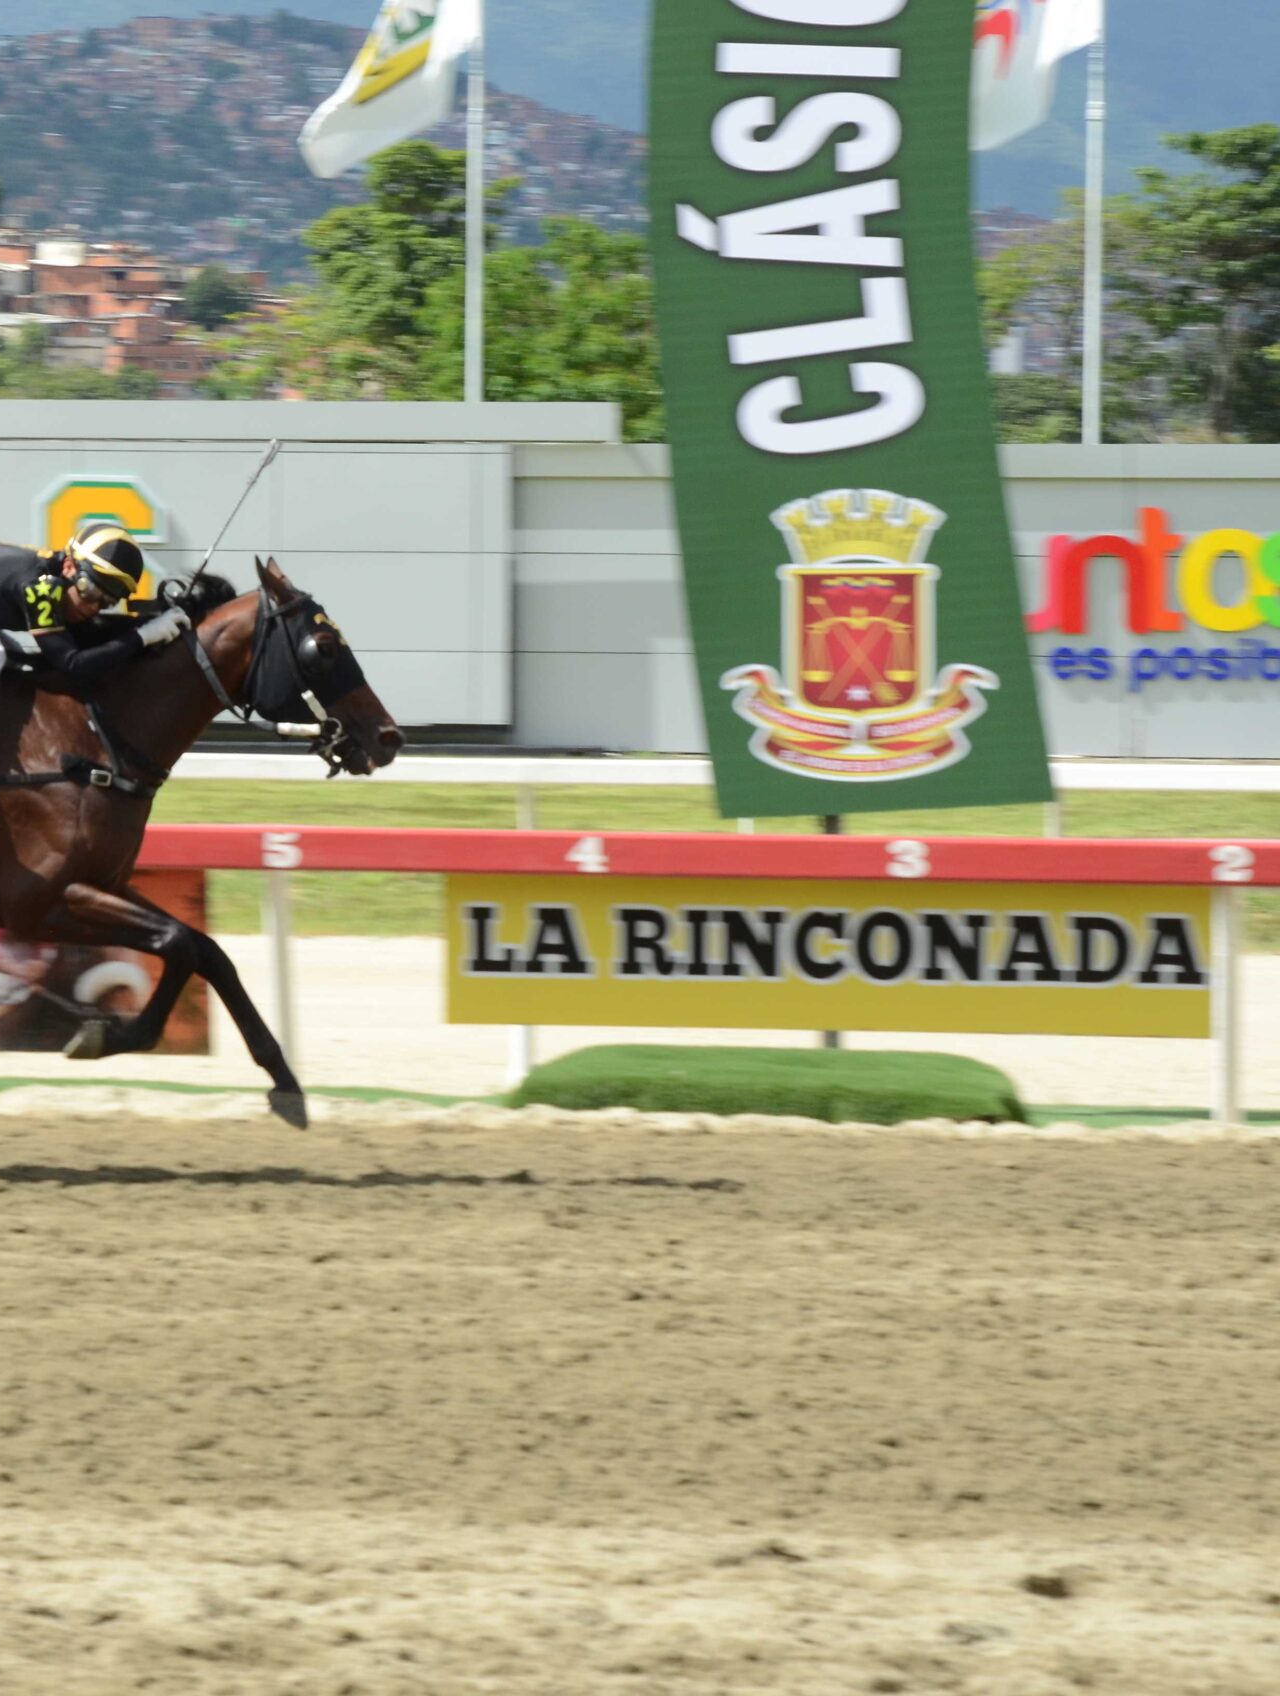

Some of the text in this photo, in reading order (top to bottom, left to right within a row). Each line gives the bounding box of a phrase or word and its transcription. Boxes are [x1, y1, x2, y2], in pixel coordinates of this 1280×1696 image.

[675, 0, 926, 455] CLÁSI
[37, 601, 53, 627] 2
[1051, 646, 1114, 681] es
[261, 832, 303, 868] 5
[565, 836, 609, 873] 4
[886, 839, 931, 879] 3
[1209, 845, 1255, 882] 2
[469, 905, 1208, 986] LA RINCONADA
